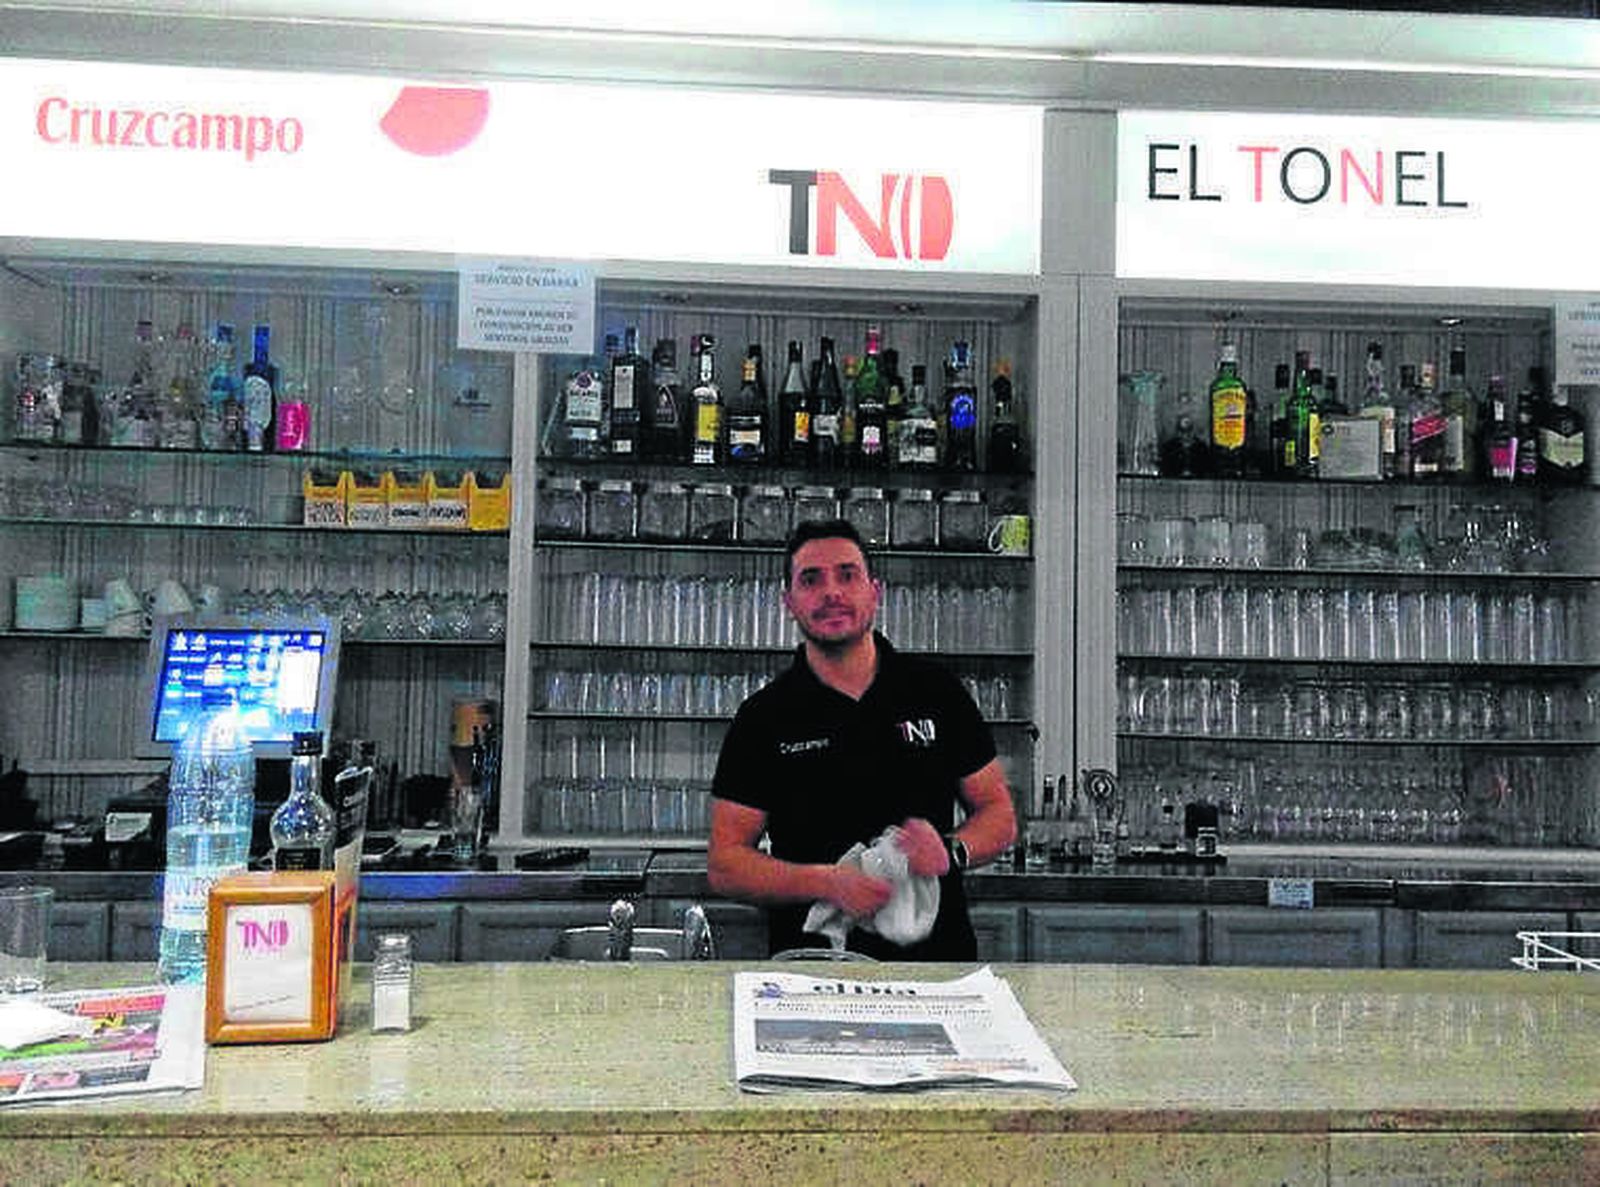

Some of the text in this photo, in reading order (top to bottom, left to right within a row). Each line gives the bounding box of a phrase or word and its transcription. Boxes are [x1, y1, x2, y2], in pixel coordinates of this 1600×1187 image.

[36, 97, 304, 162] Cruzcampo
[1148, 143, 1468, 208] EL TONEL
